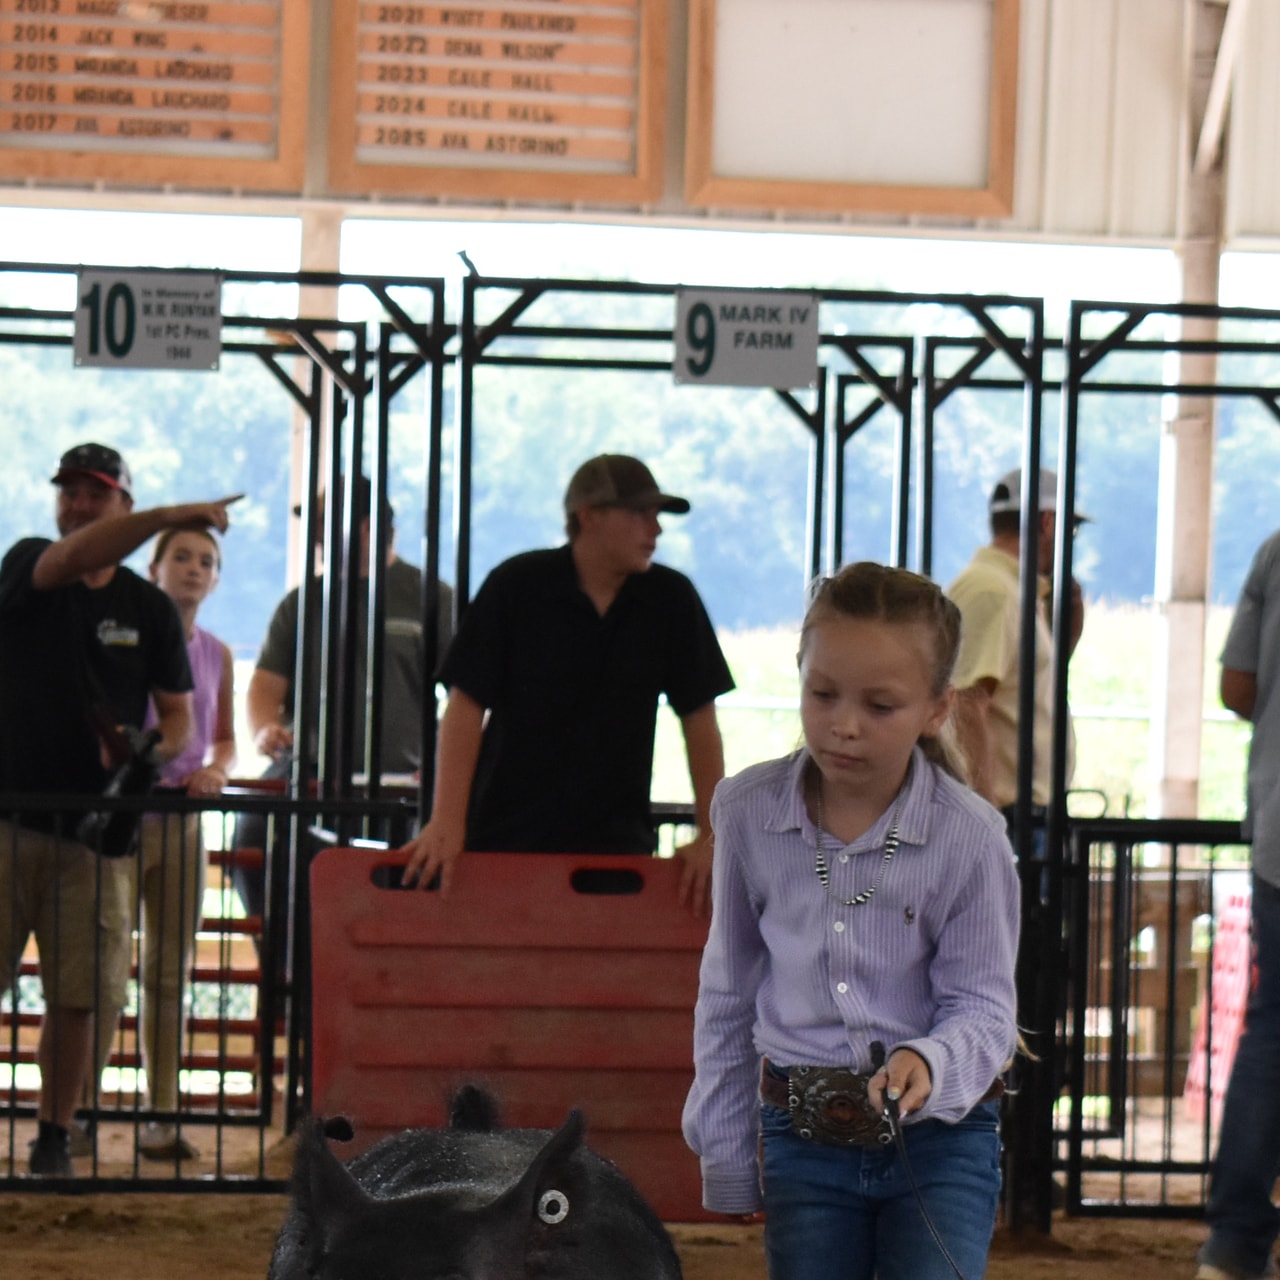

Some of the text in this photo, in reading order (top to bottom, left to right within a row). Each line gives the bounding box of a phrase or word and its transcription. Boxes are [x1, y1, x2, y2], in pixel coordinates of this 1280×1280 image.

[378, 6, 425, 25] 2021
[12, 25, 58, 42] 2014
[12, 54, 59, 72] 2015
[377, 65, 428, 84] 2023
[511, 74, 554, 93] HALL
[12, 85, 57, 103] 2016
[375, 96, 426, 114] 2024
[11, 114, 57, 132] 2017
[440, 132, 469, 149] AVA
[82, 281, 137, 359] 10
[719, 305, 810, 325] MARK IV
[686, 302, 716, 377] 9
[734, 331, 794, 350] FARM
